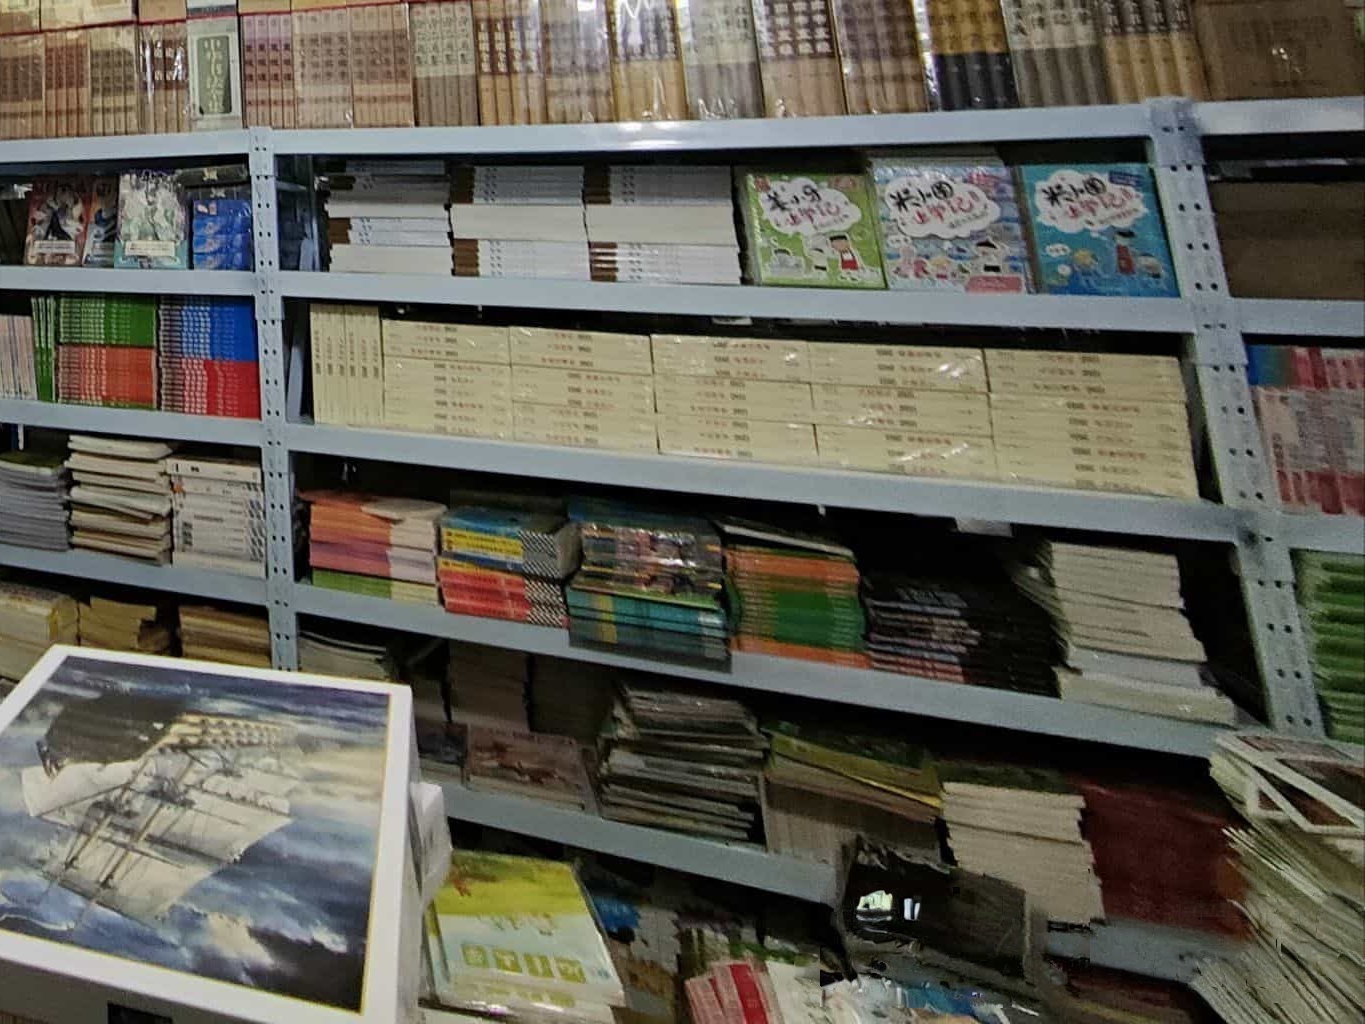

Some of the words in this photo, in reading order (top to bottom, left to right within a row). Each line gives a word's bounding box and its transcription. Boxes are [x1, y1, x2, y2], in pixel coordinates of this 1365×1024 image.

[890, 180, 954, 211] 米小圈
[1041, 177, 1107, 207] 米小圈
